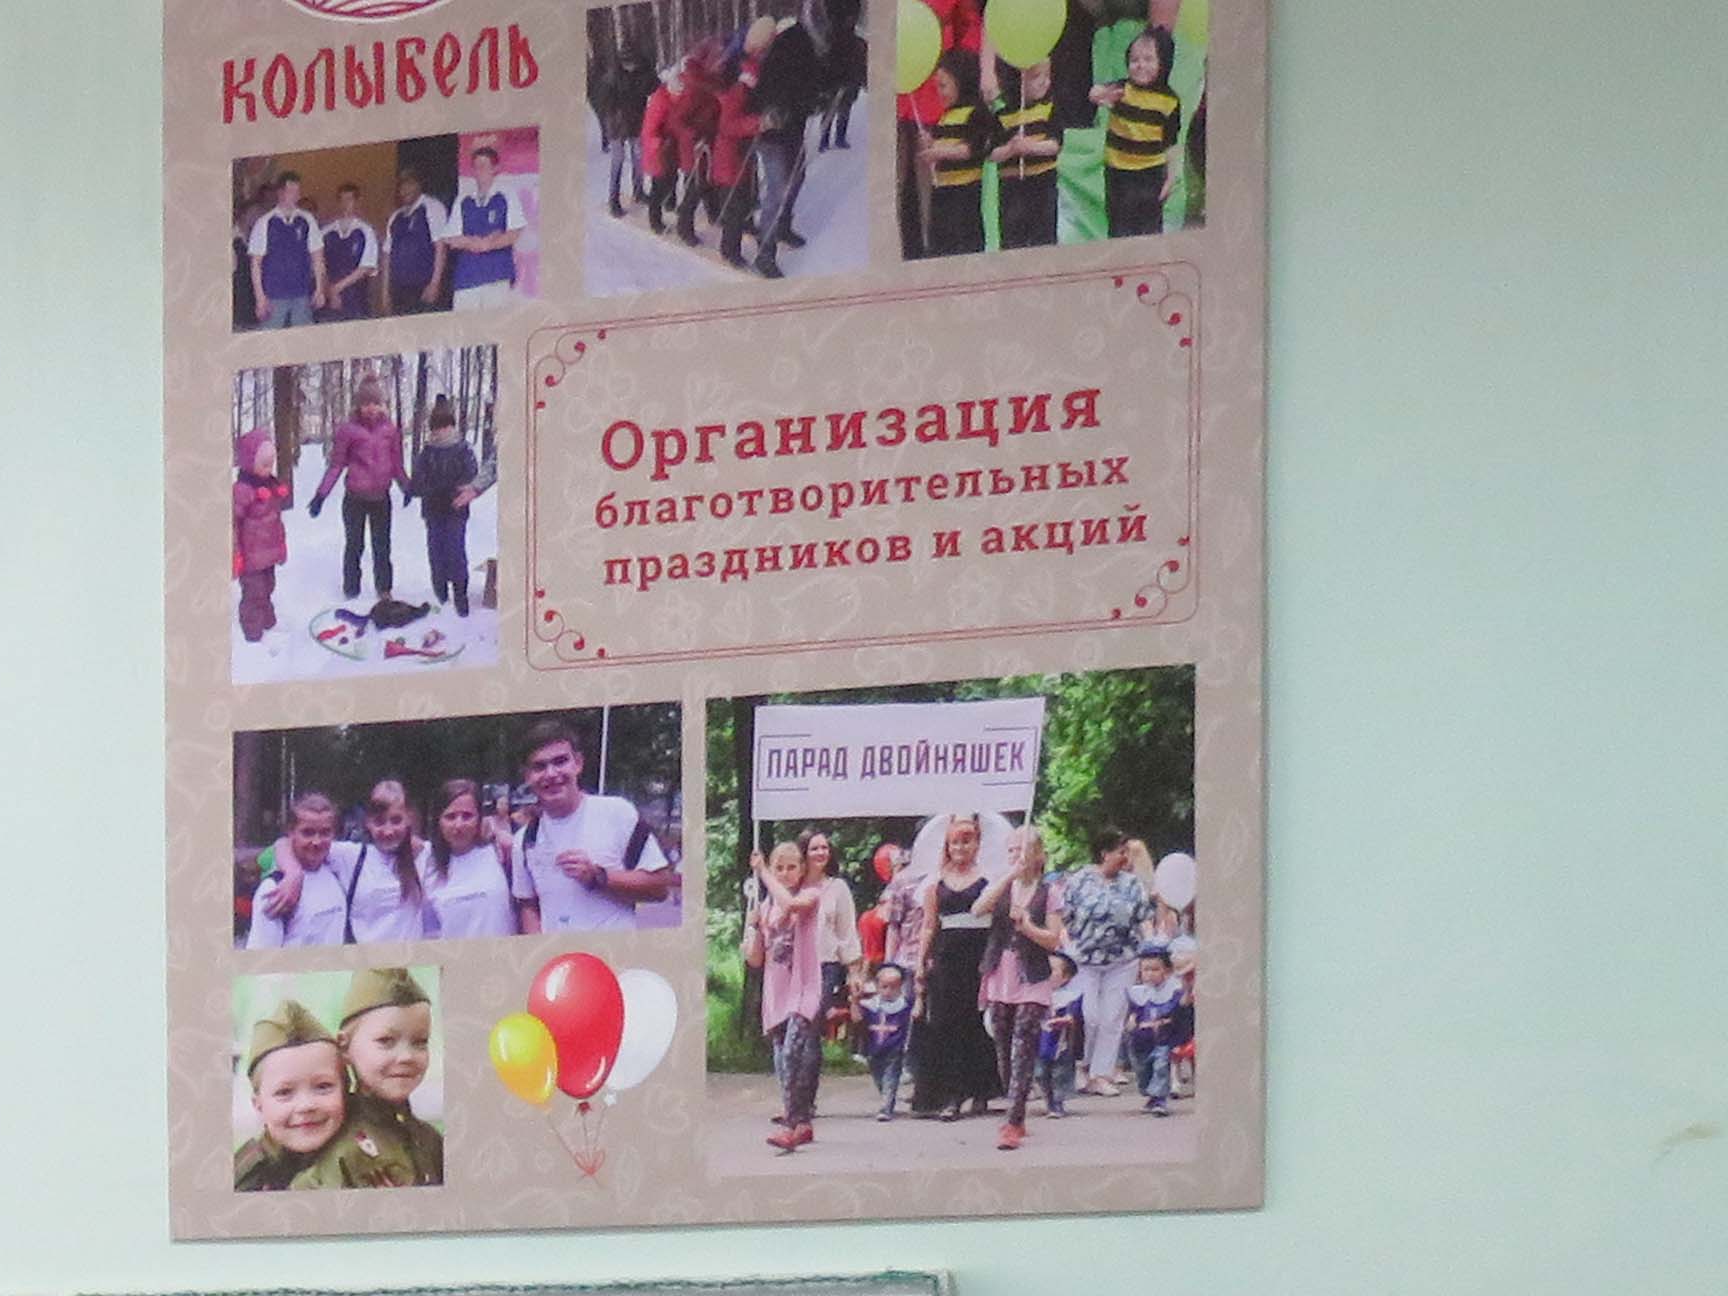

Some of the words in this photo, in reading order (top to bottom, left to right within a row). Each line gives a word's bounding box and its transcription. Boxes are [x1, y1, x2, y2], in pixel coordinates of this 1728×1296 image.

[600, 388, 1102, 481] Организация
[594, 456, 1130, 529] благотворительных
[603, 533, 912, 592] праздников
[931, 528, 962, 559] и
[981, 504, 1148, 556] акций
[766, 747, 849, 780] ПАРАД
[860, 739, 1027, 780] ДВОЙНЯШЕК
